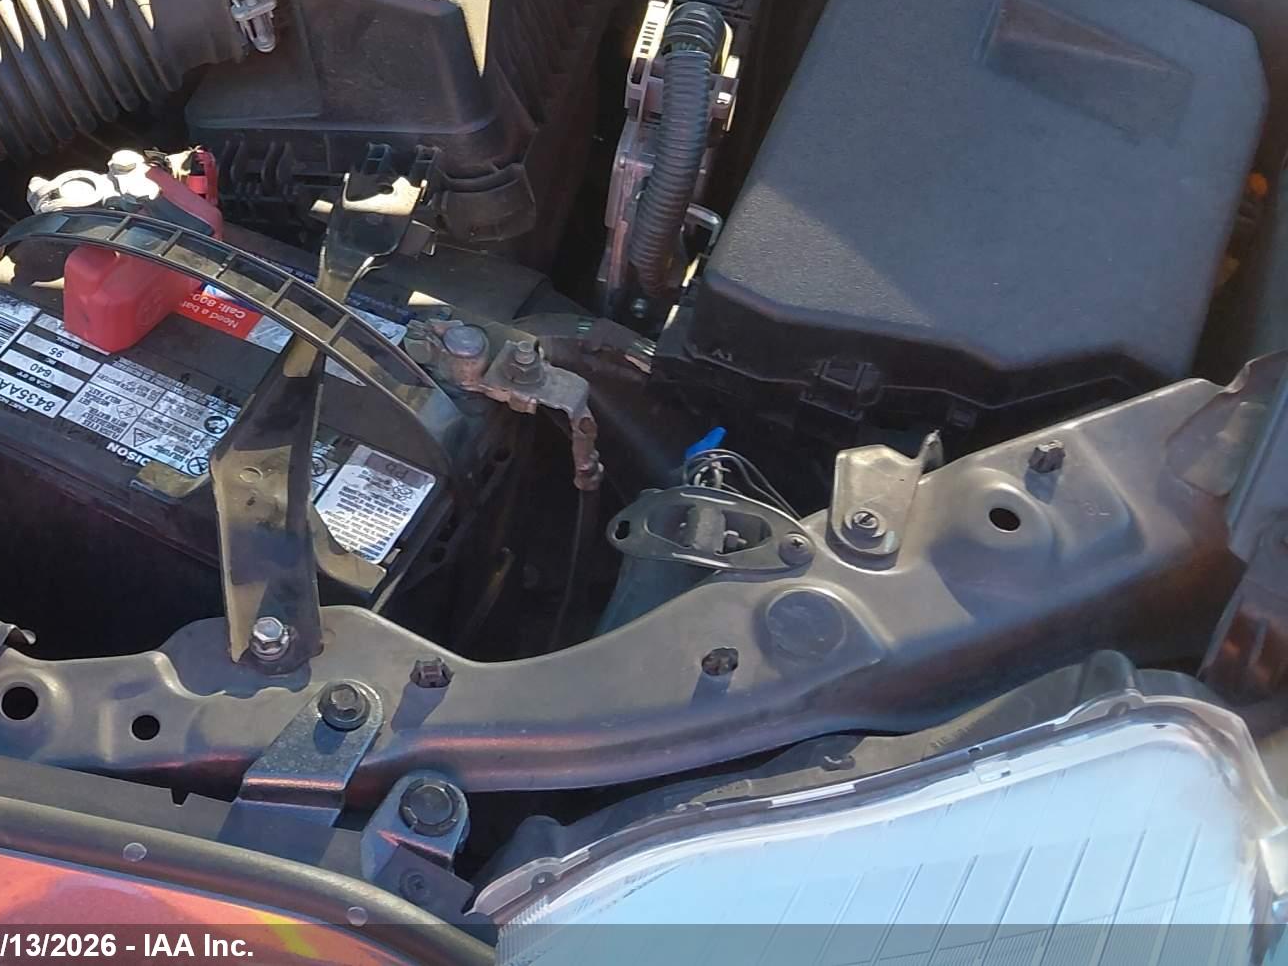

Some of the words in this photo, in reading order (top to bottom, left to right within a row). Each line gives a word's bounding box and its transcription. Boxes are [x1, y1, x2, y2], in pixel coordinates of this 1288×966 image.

[218, 304, 246, 319] Call:
[211, 312, 239, 328] Need
[49, 347, 64, 358] 95
[30, 363, 52, 377] 640
[9, 402, 28, 412] PART
